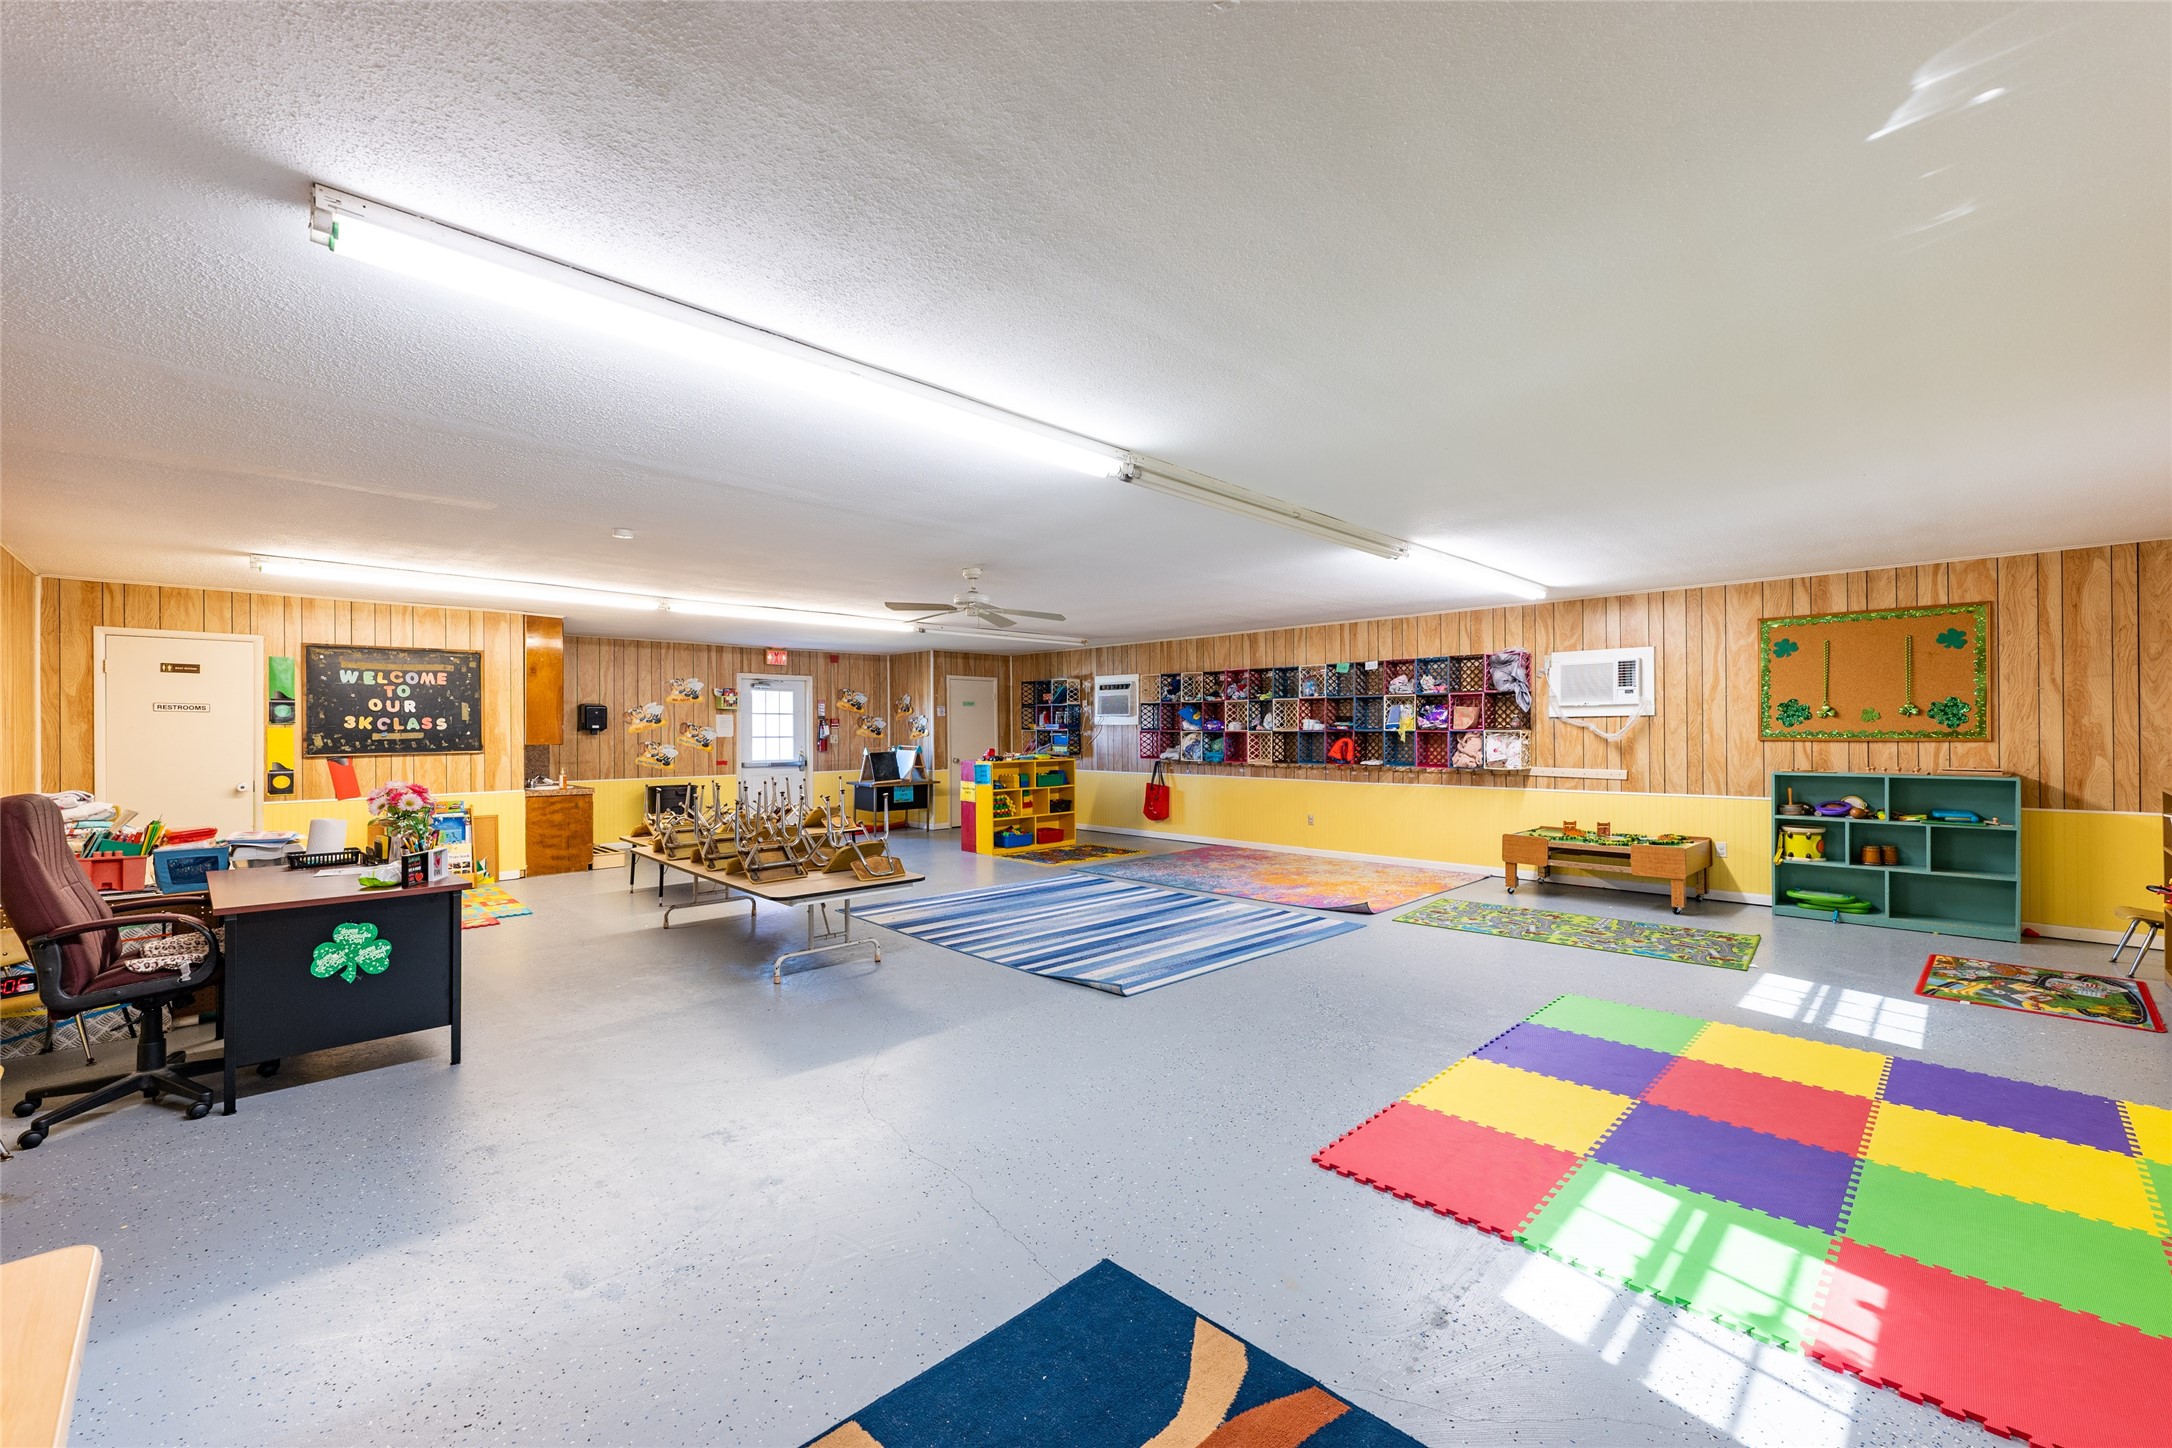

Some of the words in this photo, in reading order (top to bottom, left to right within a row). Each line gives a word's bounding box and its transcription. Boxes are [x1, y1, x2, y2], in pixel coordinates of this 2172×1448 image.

[339, 669, 448, 685] WELCOME
[383, 684, 411, 698] TO
[368, 698, 416, 713] OUR
